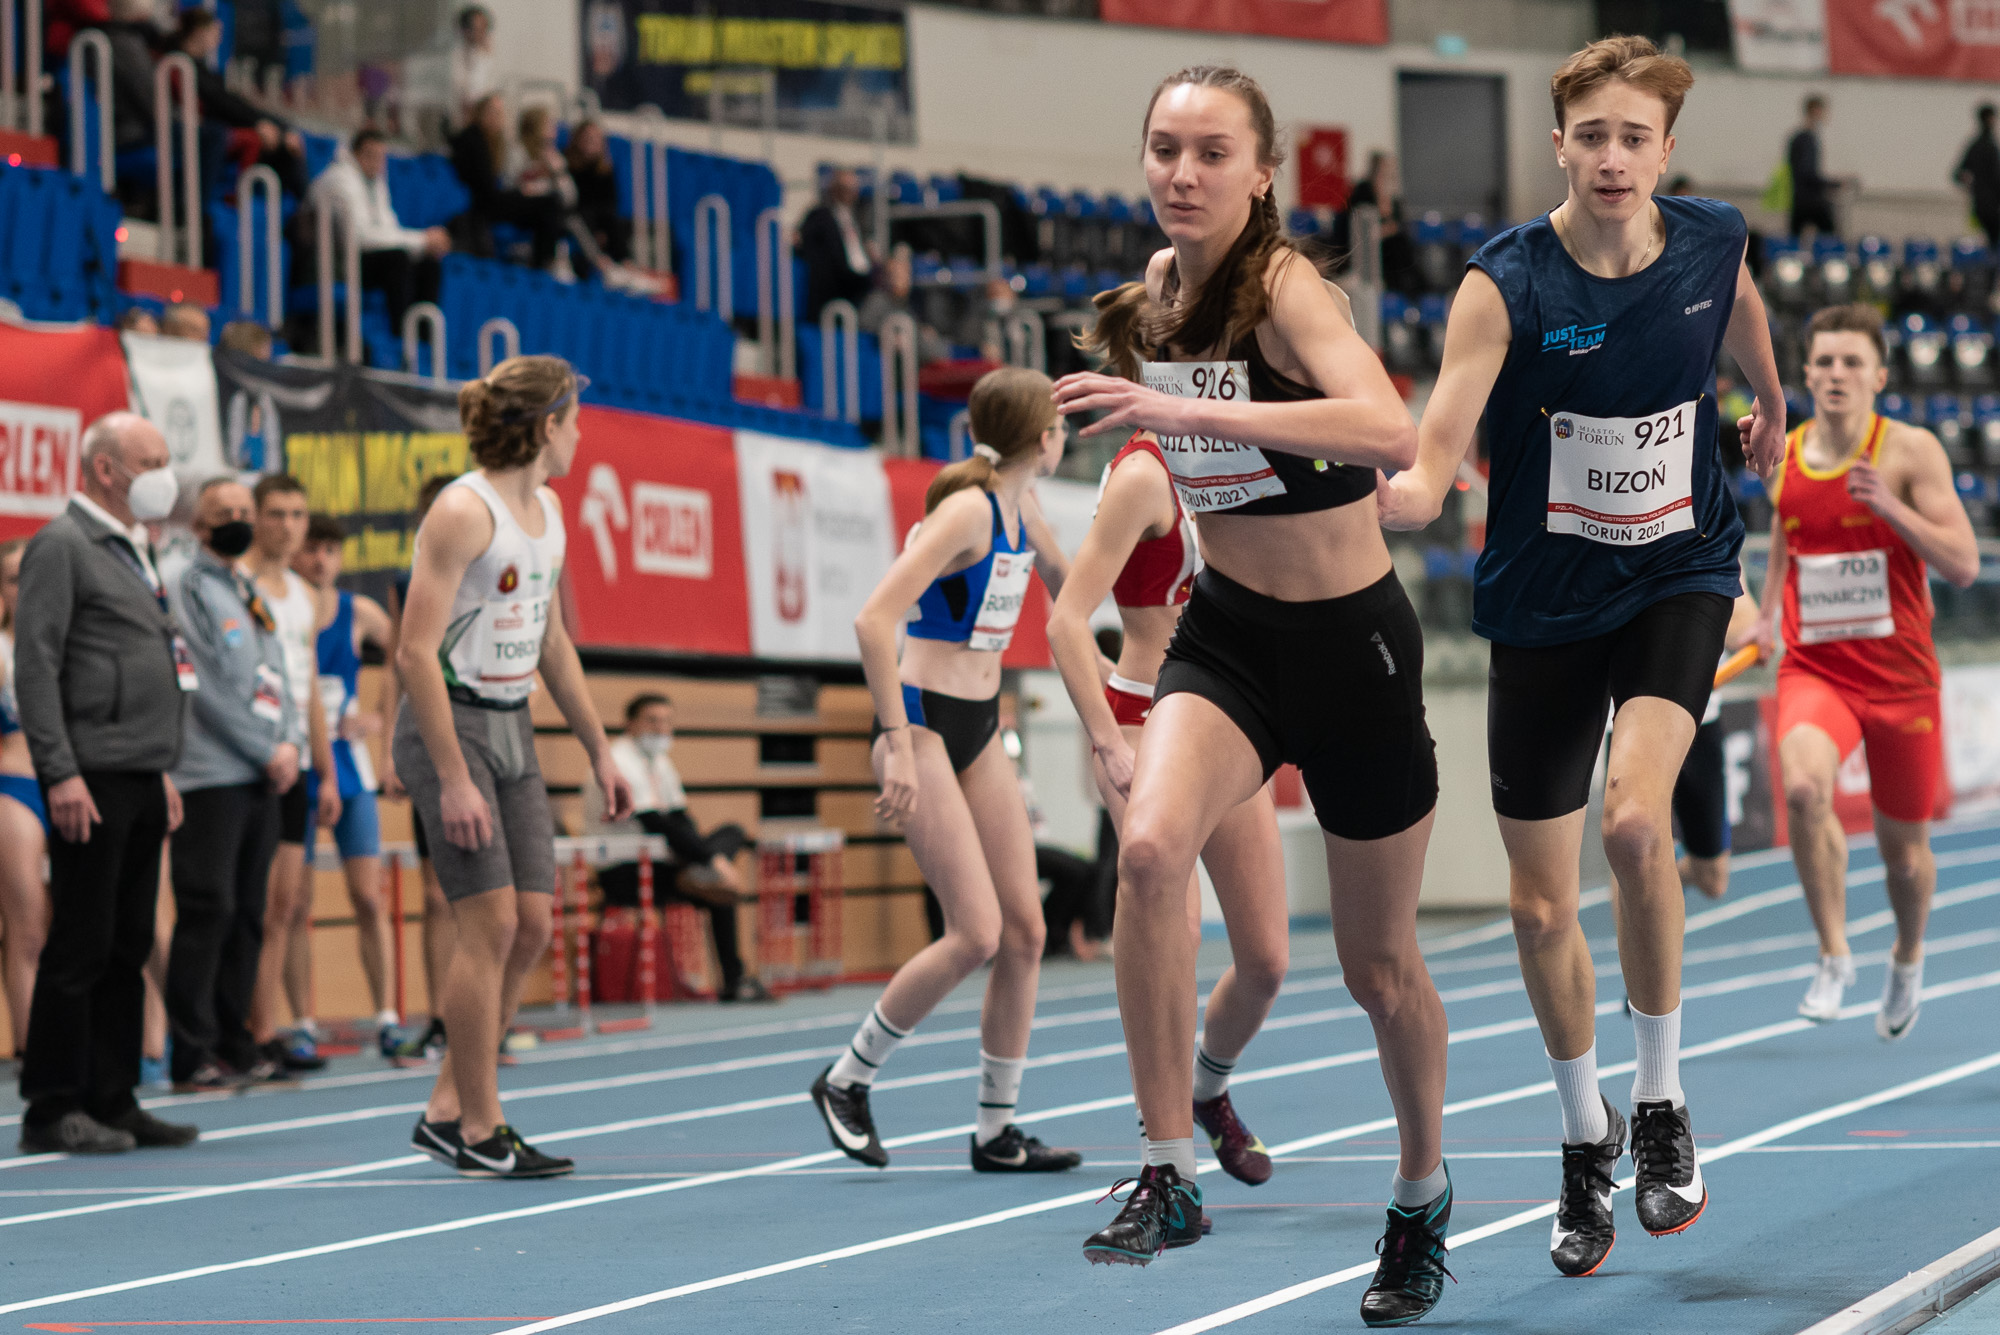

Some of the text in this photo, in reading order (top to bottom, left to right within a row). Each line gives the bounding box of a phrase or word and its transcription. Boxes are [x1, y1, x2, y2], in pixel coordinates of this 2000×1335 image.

[1542, 325, 1578, 346] JUST
[1568, 330, 1606, 349] TEAM
[1192, 367, 1236, 400] 926
[1577, 432, 1625, 446] TORUŃ
[1579, 409, 1685, 450] MIASTO 921
[1588, 460, 1666, 493] BIZOŃ
[1181, 486, 1251, 507] TORUŃ 2021
[1574, 507, 1600, 520] HALOWE
[1600, 514, 1648, 523] MISTRZOSTWA
[1580, 520, 1665, 542] TORUŃ 2021
[1838, 557, 1880, 577] 703
[1378, 641, 1397, 676] Reebok
